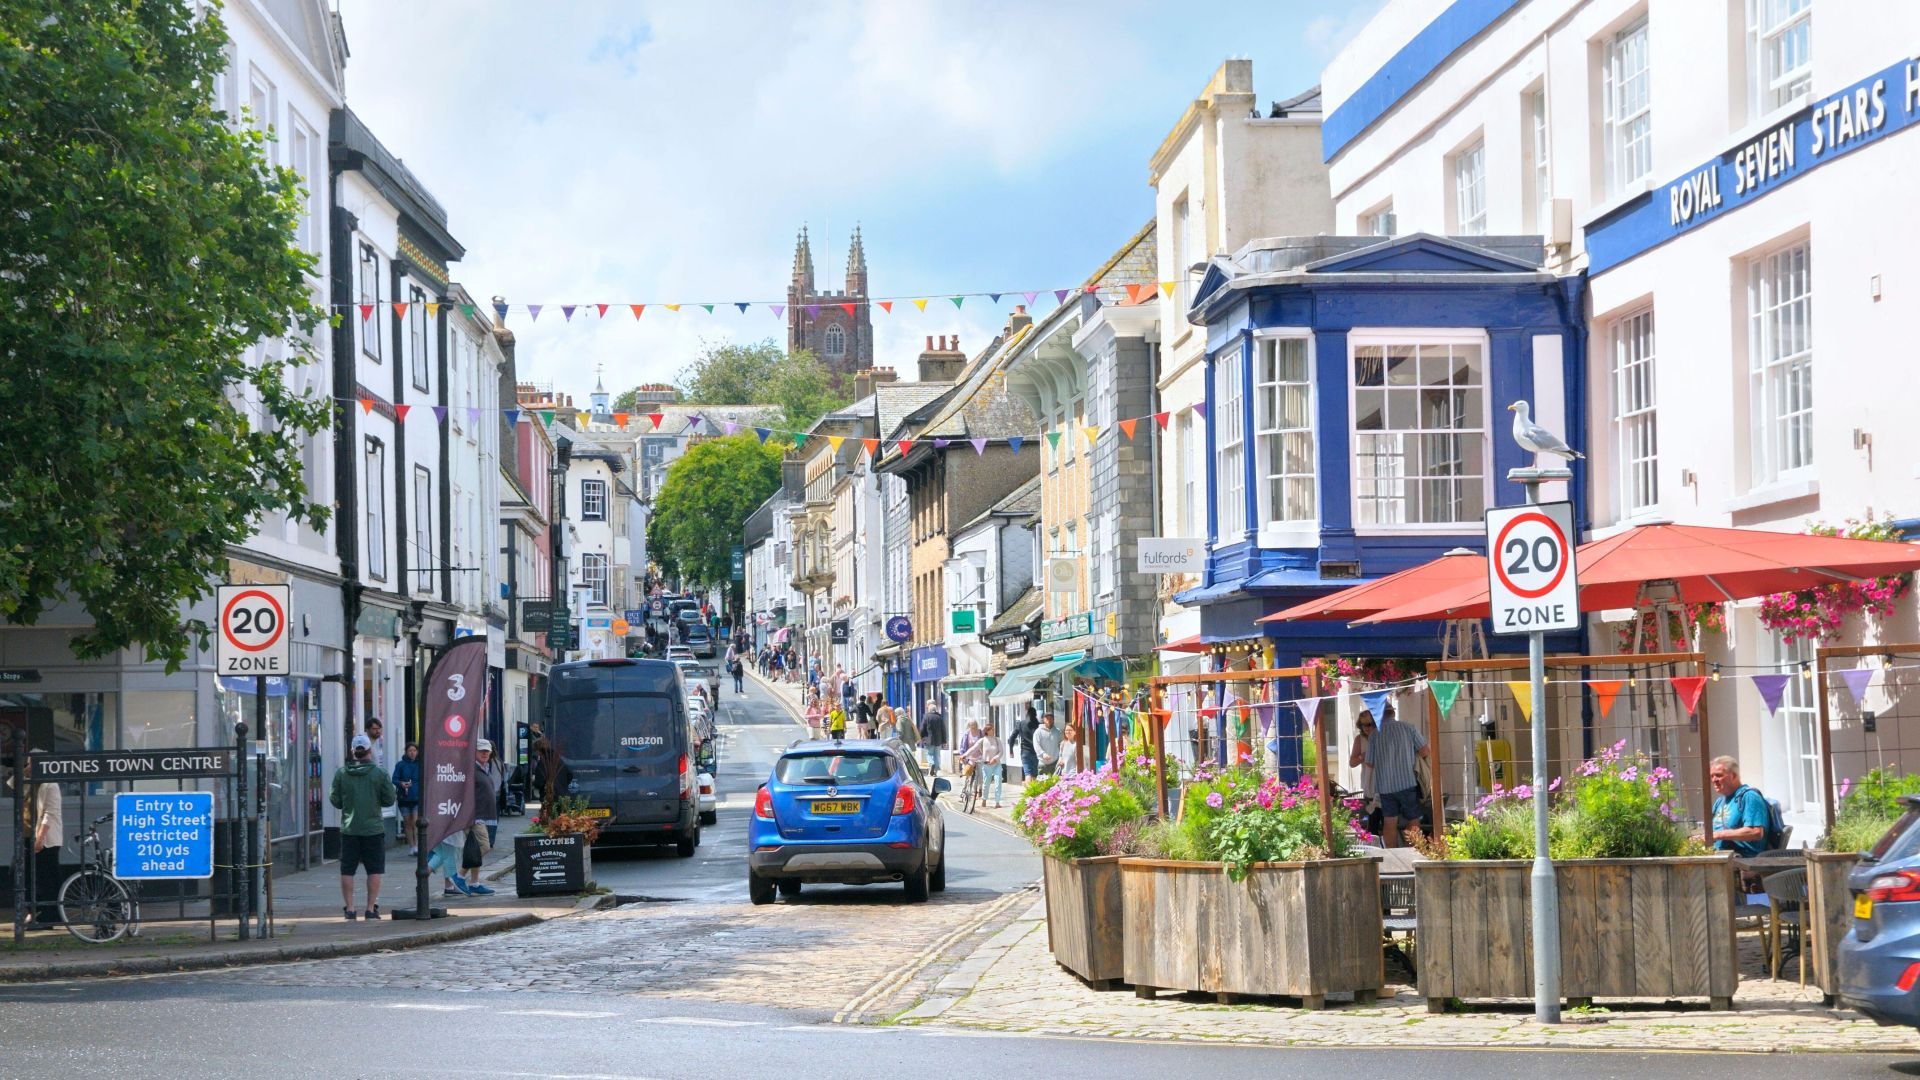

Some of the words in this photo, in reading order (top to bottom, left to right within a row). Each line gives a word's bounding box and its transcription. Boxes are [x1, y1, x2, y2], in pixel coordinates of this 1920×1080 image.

[1670, 165, 1721, 226] ROYAL
[1735, 122, 1795, 194] SEVEN
[1811, 79, 1885, 155] STARS
[1144, 552, 1187, 564] fulfords
[1505, 536, 1558, 575] 20
[232, 607, 276, 634] 20
[1504, 604, 1565, 626] ZONE
[228, 657, 278, 670] ZONE
[447, 673, 466, 701] 3
[621, 736, 663, 746] amazon
[39, 759, 99, 774] TOTNES
[107, 758, 154, 772] TOWN
[161, 756, 222, 770] CENTRE
[437, 763, 455, 774] talk
[437, 771, 466, 782] mobile
[136, 799, 173, 813] Entry
[179, 800, 193, 811] to
[438, 799, 462, 818] sky
[813, 802, 838, 812] WG67
[840, 801, 860, 811] WBK
[122, 815, 155, 829] High
[161, 814, 206, 826] Street
[128, 829, 198, 841] restricted
[137, 844, 163, 856] 210
[165, 844, 190, 858] yds
[531, 852, 541, 860] THE
[141, 859, 185, 871] ahead
